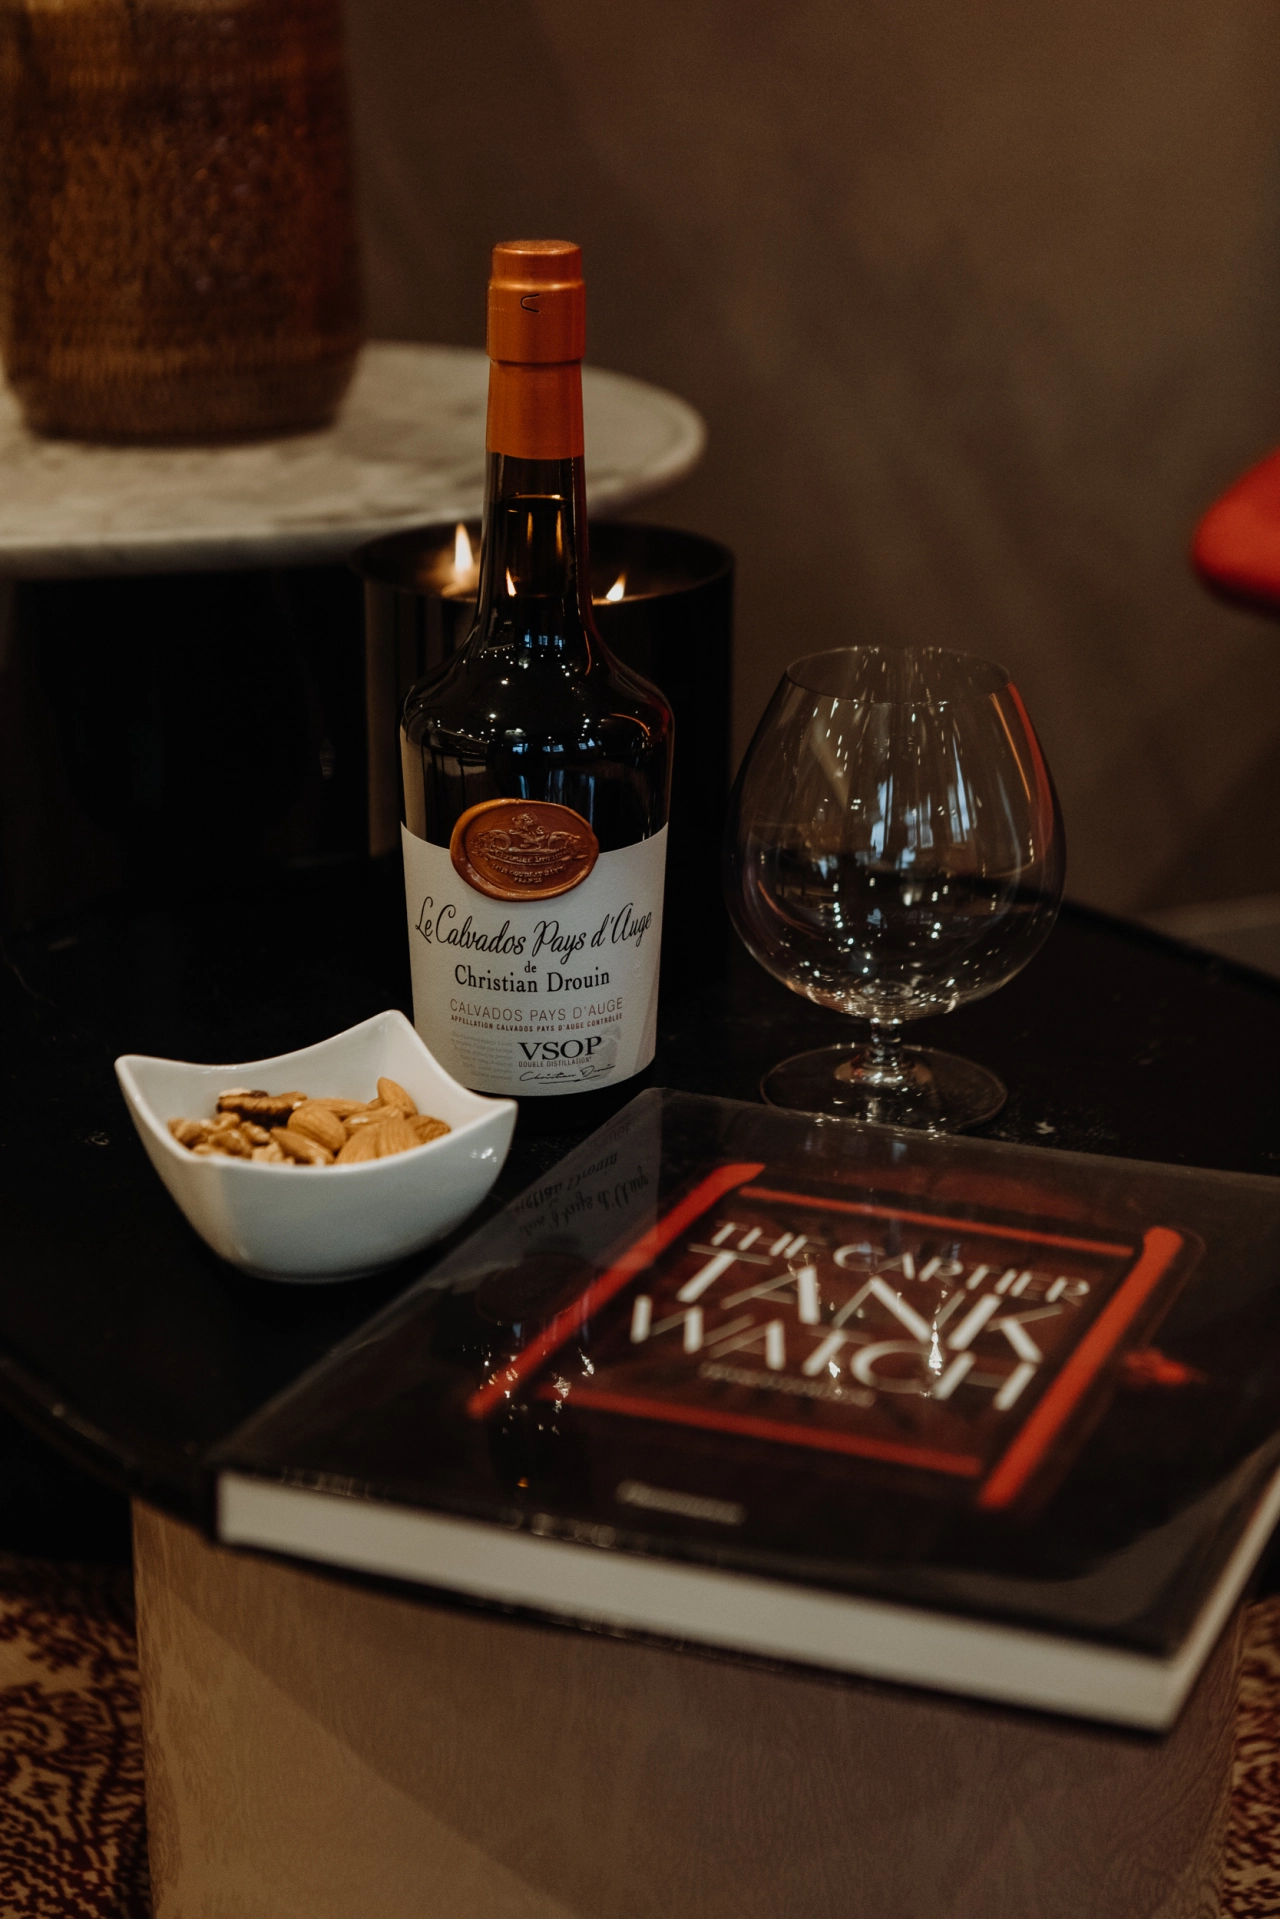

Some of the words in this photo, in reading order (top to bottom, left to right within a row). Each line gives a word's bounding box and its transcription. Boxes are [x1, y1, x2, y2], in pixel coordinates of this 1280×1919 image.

[415, 896, 434, 944] Le
[435, 904, 527, 955] Calvados
[532, 920, 586, 965] Pays
[591, 902, 652, 948] d'Auge
[454, 964, 538, 993] Christian
[547, 966, 610, 993] Drouin
[524, 960, 537, 973] de
[450, 998, 523, 1022] CALVADOS
[530, 1008, 566, 1023] PAYS
[573, 997, 623, 1019] D'AUGE
[451, 1014, 494, 1029] APPELLATION
[496, 1022, 533, 1032] CALVADOS
[558, 1022, 584, 1031] D'AUGE
[517, 1036, 602, 1061] VSOP
[518, 1060, 544, 1068] DOUBLE
[711, 1222, 826, 1259] THE
[833, 1243, 1090, 1305] CARTIER
[677, 1242, 1064, 1362] TANK
[630, 1294, 1039, 1411] WATCH
